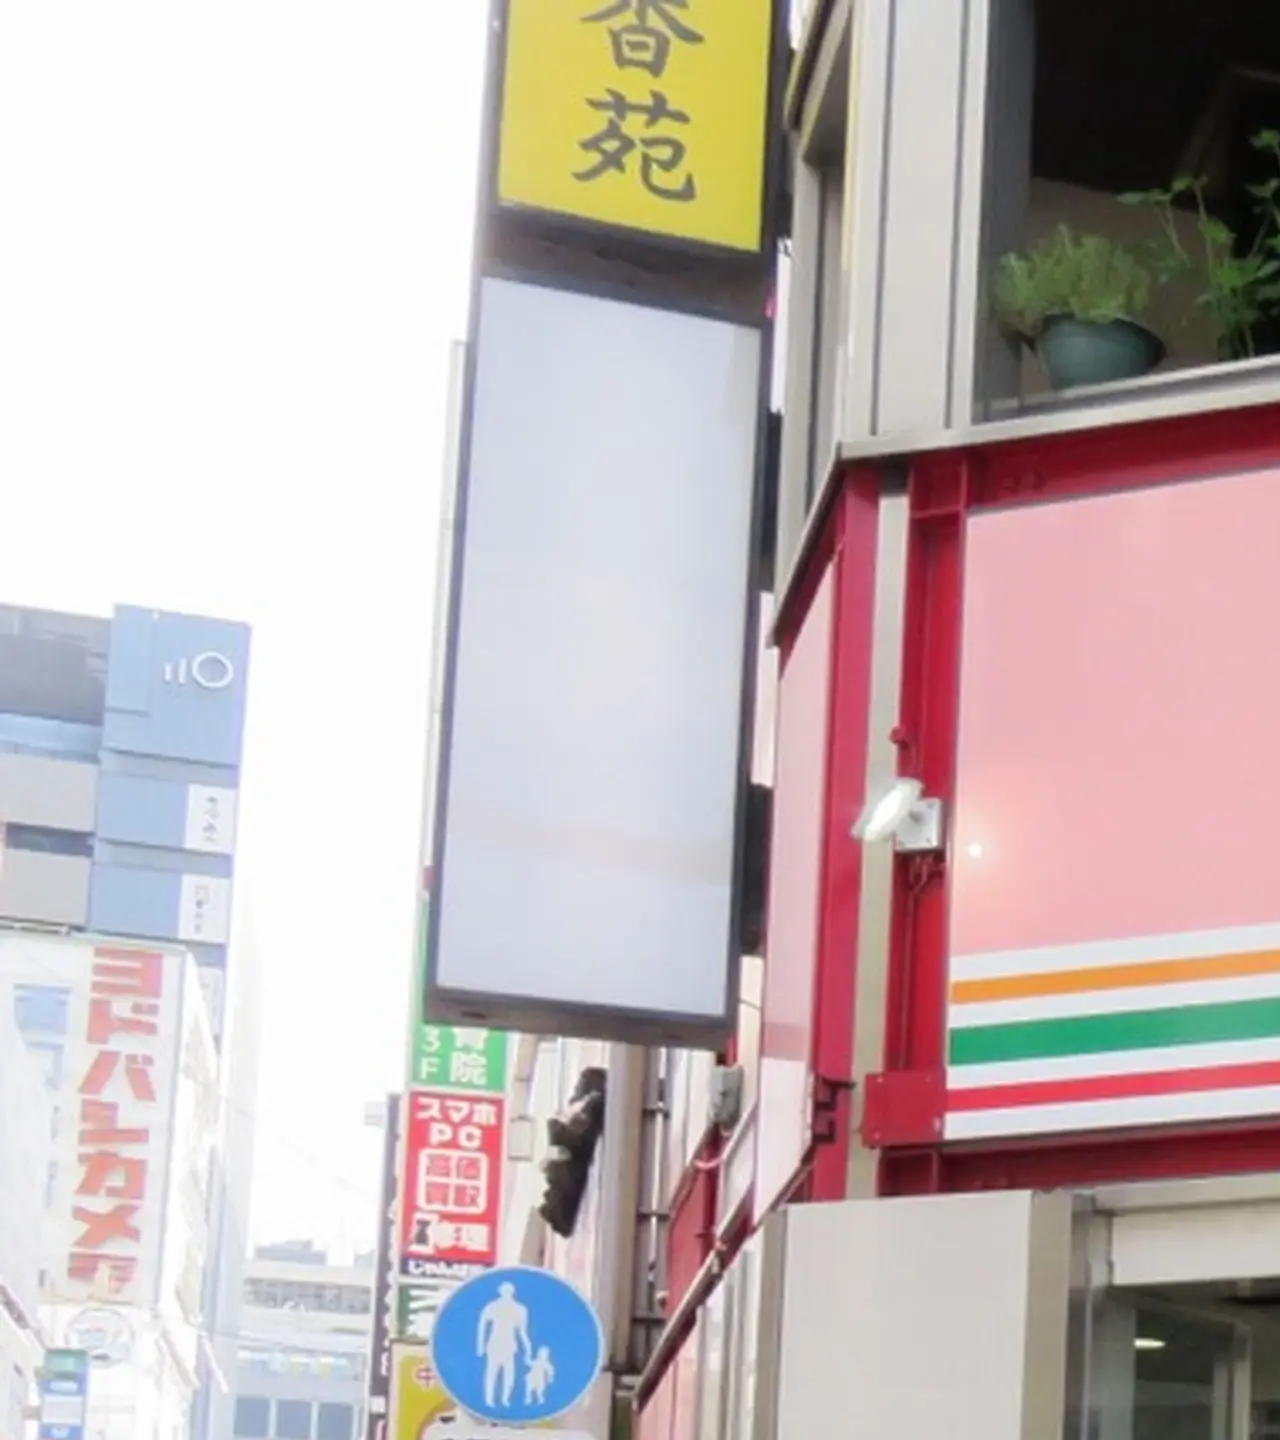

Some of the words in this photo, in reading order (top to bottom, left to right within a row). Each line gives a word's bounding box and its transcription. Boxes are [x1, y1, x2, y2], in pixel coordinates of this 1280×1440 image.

[417, 1097, 498, 1126] スマホ
[429, 1122, 484, 1149] PC
